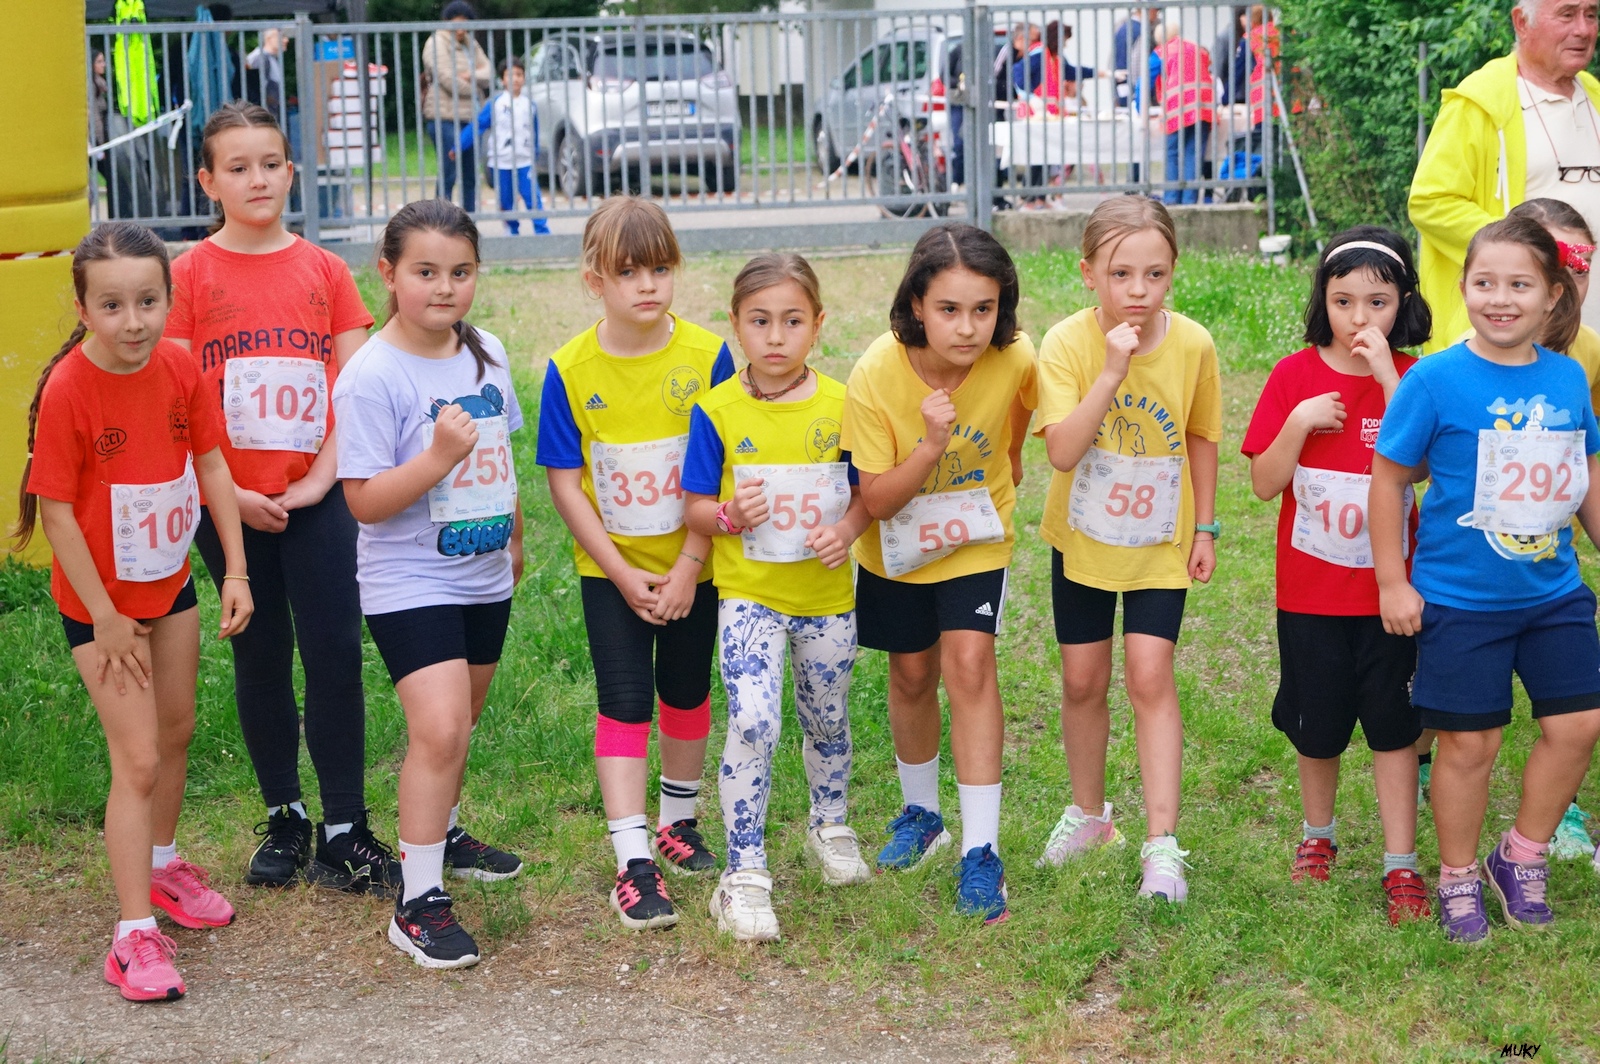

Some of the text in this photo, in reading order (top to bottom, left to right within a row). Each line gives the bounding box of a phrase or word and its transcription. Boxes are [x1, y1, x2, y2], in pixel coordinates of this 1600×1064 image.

[250, 383, 317, 423] 102
[585, 403, 608, 411] adidas
[1362, 417, 1382, 429] PODI
[453, 445, 509, 489] 253
[734, 446, 759, 454] adidas
[610, 465, 685, 507] 334
[1105, 482, 1156, 520] 58
[1499, 462, 1572, 502] 292
[139, 494, 194, 549] 108
[771, 493, 822, 531] 55
[1315, 499, 1364, 539] 10
[919, 518, 970, 554] 59
